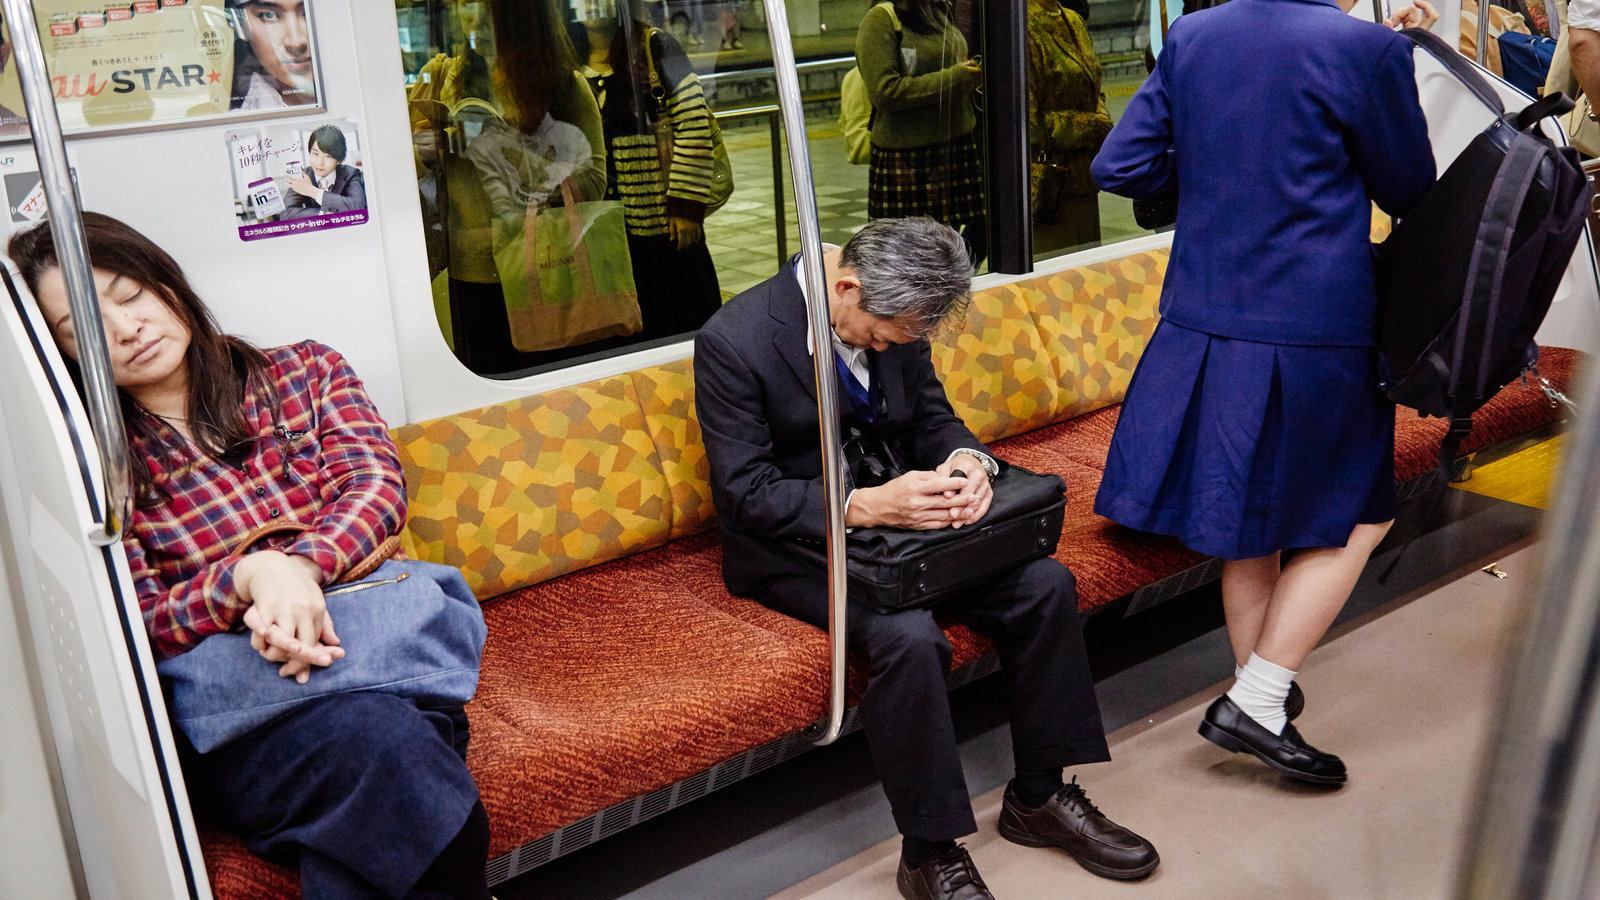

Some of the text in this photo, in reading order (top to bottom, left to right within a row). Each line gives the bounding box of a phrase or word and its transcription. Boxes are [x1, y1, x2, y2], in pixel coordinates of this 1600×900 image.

[111, 64, 207, 94] STAR
[238, 137, 273, 155] キレイを
[0, 157, 15, 166] JR
[22, 191, 43, 212] マナー
[254, 194, 268, 206] in
[330, 214, 365, 224] マルチミネラル
